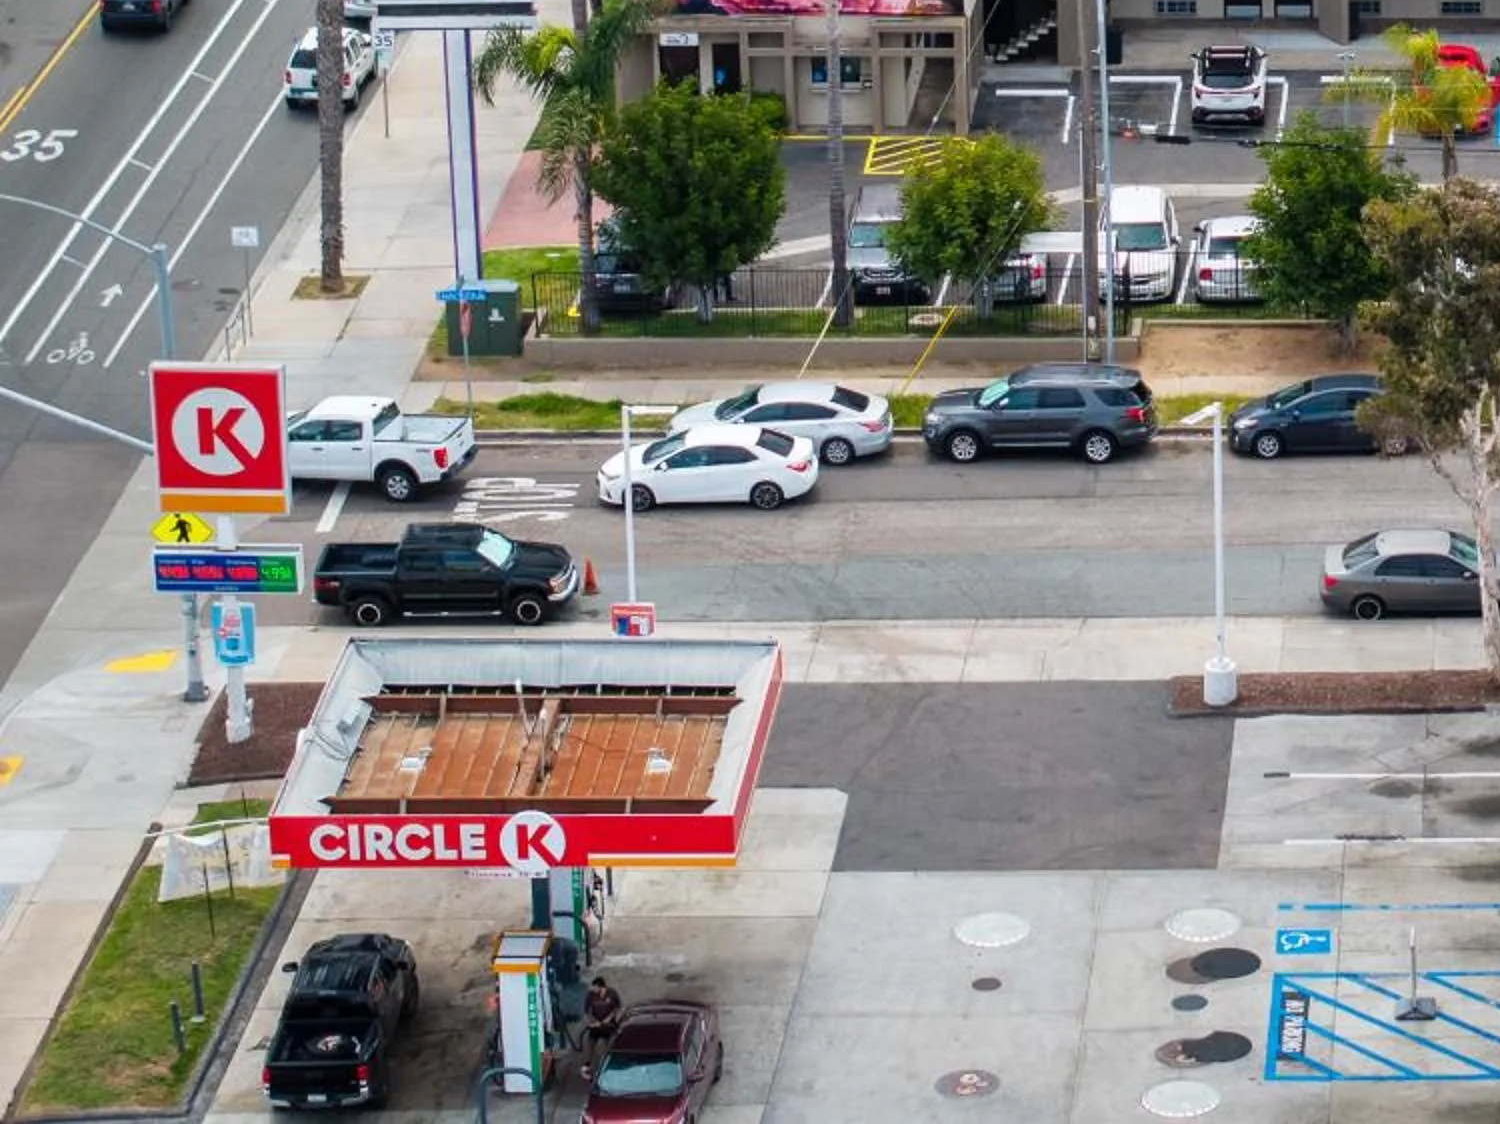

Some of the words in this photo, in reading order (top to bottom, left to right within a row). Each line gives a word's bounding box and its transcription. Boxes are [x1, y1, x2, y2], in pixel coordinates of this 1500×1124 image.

[375, 35, 393, 46] 35
[0, 129, 79, 162] 35
[196, 406, 257, 471] K
[309, 823, 487, 861] CIRCLE
[515, 823, 561, 865] K
